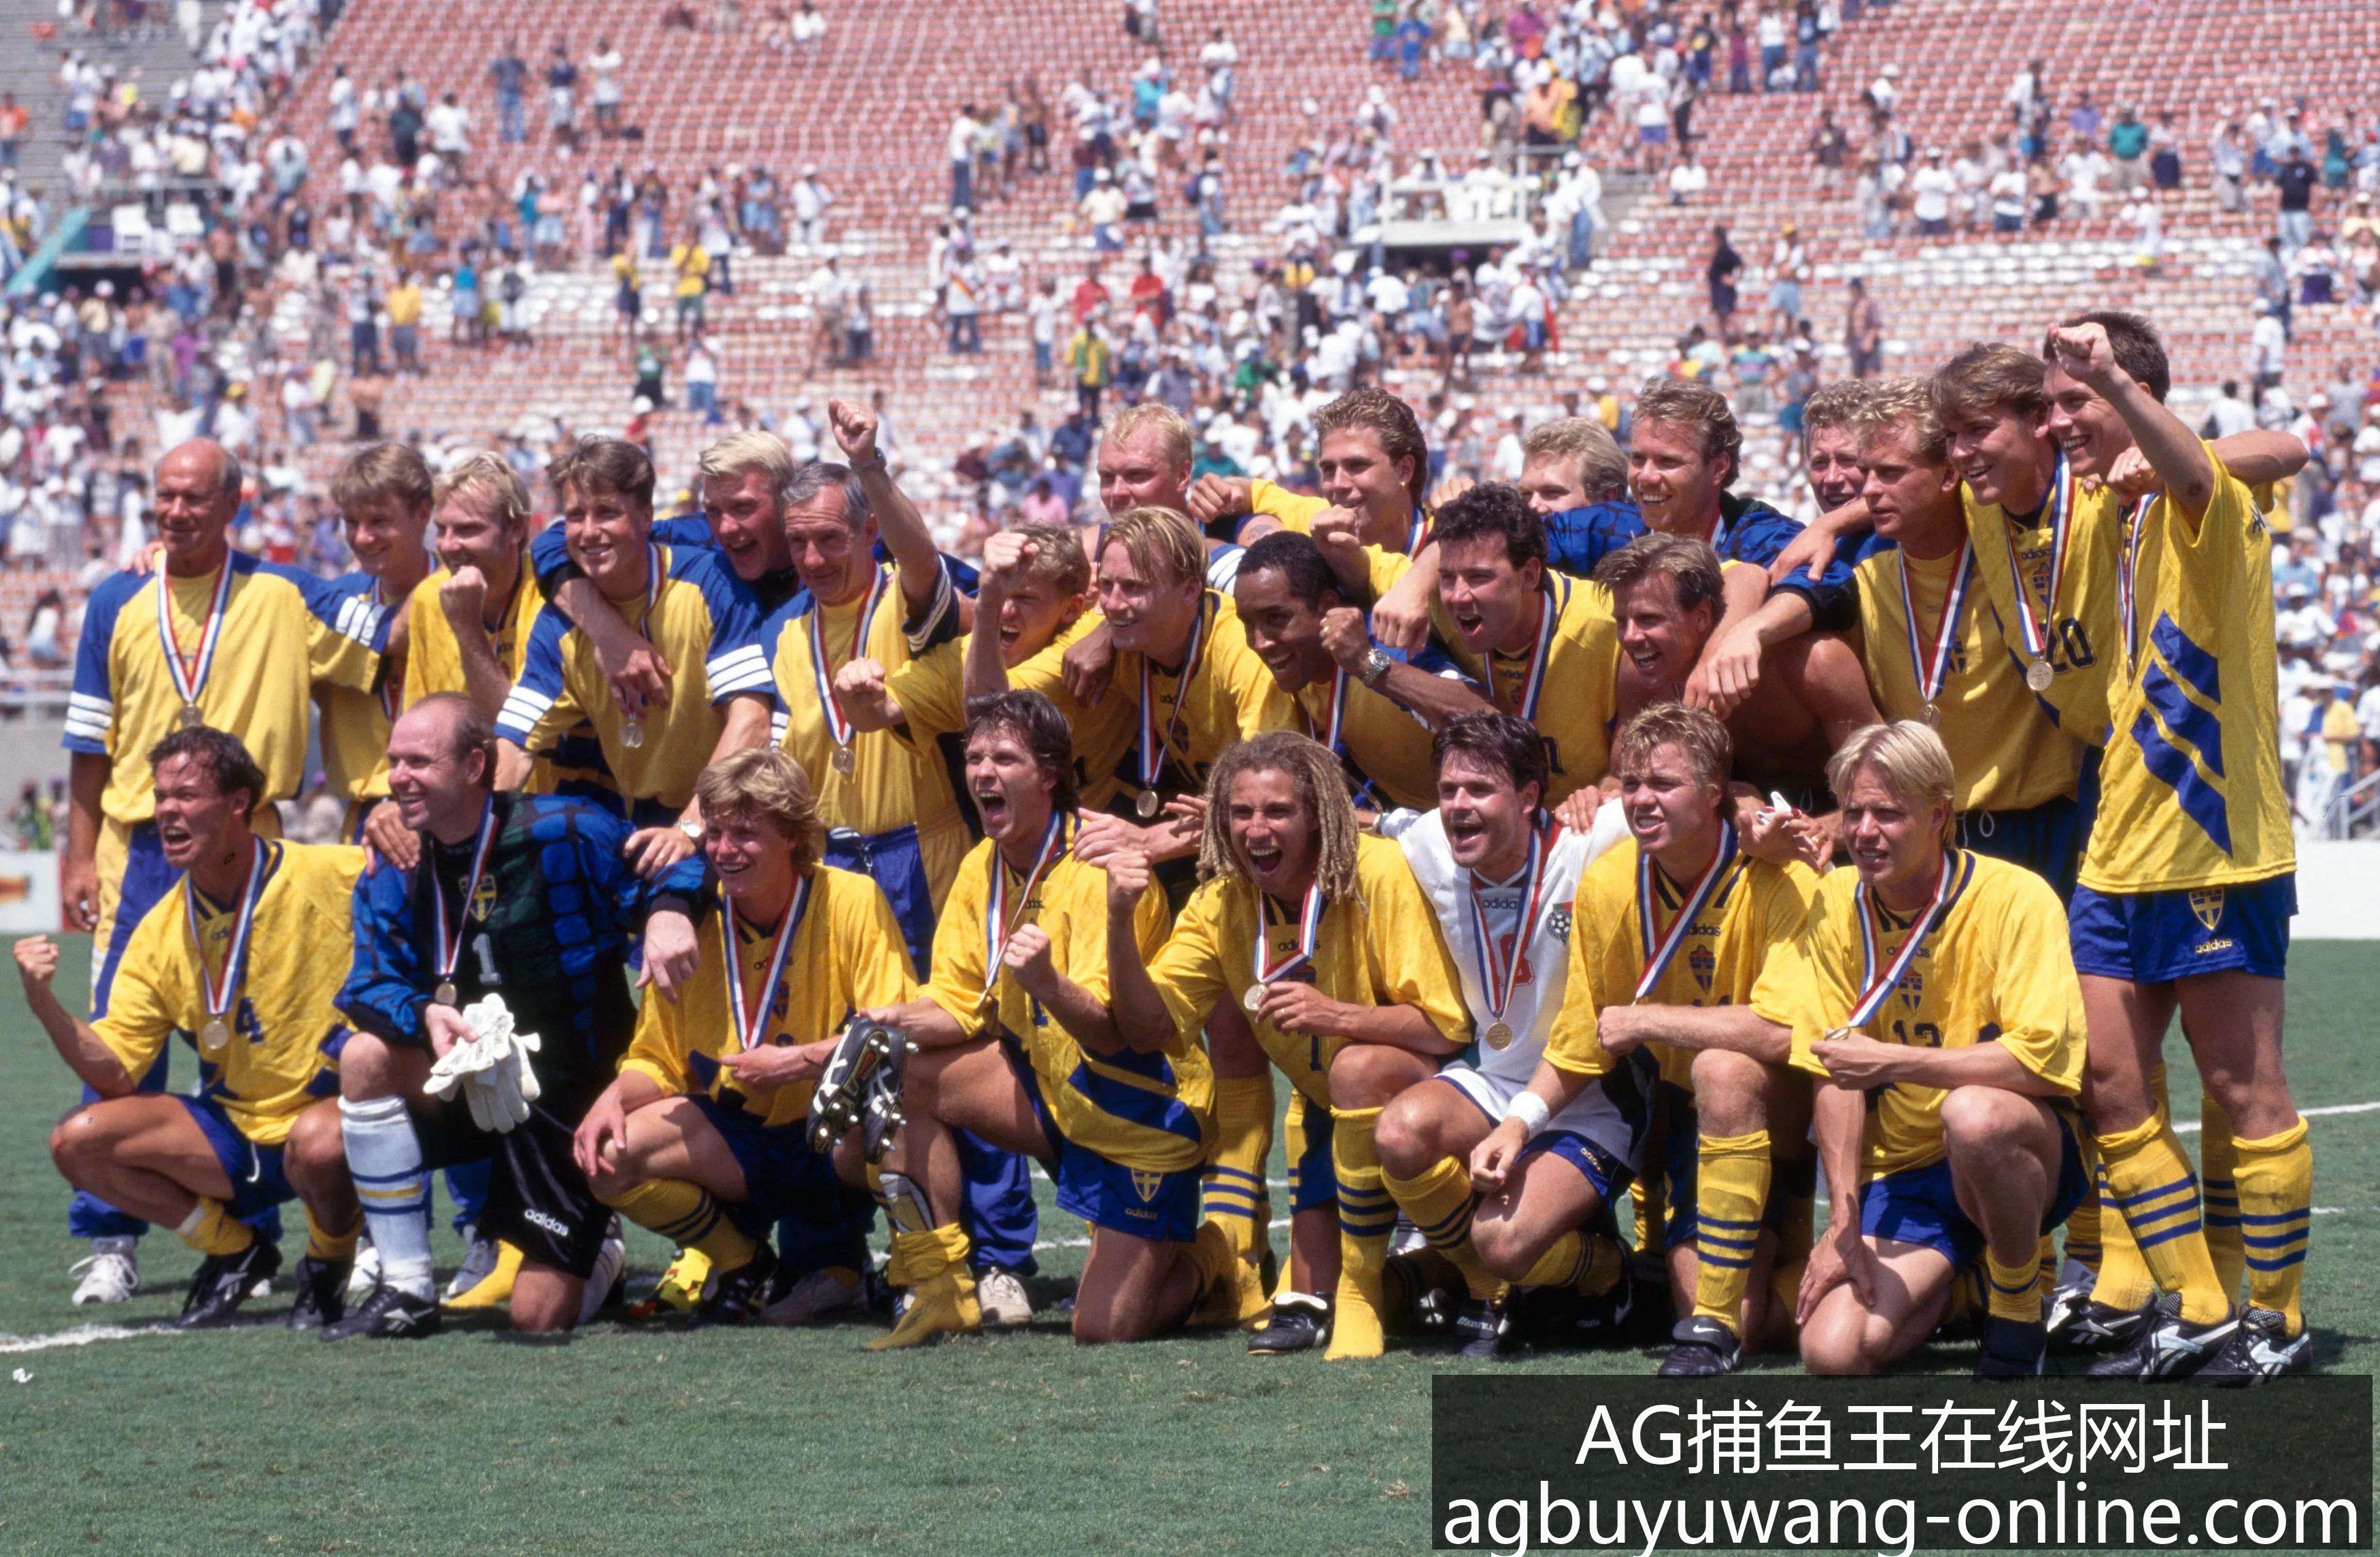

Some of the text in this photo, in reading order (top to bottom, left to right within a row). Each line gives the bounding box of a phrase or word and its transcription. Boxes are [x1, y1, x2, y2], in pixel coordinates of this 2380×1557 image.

[1482, 898, 1517, 910] adida
[1688, 923, 1722, 937] didas
[2195, 939, 2233, 953] adidas
[472, 933, 502, 985] 1
[235, 997, 266, 1044] 4
[524, 1208, 568, 1237] adidas
